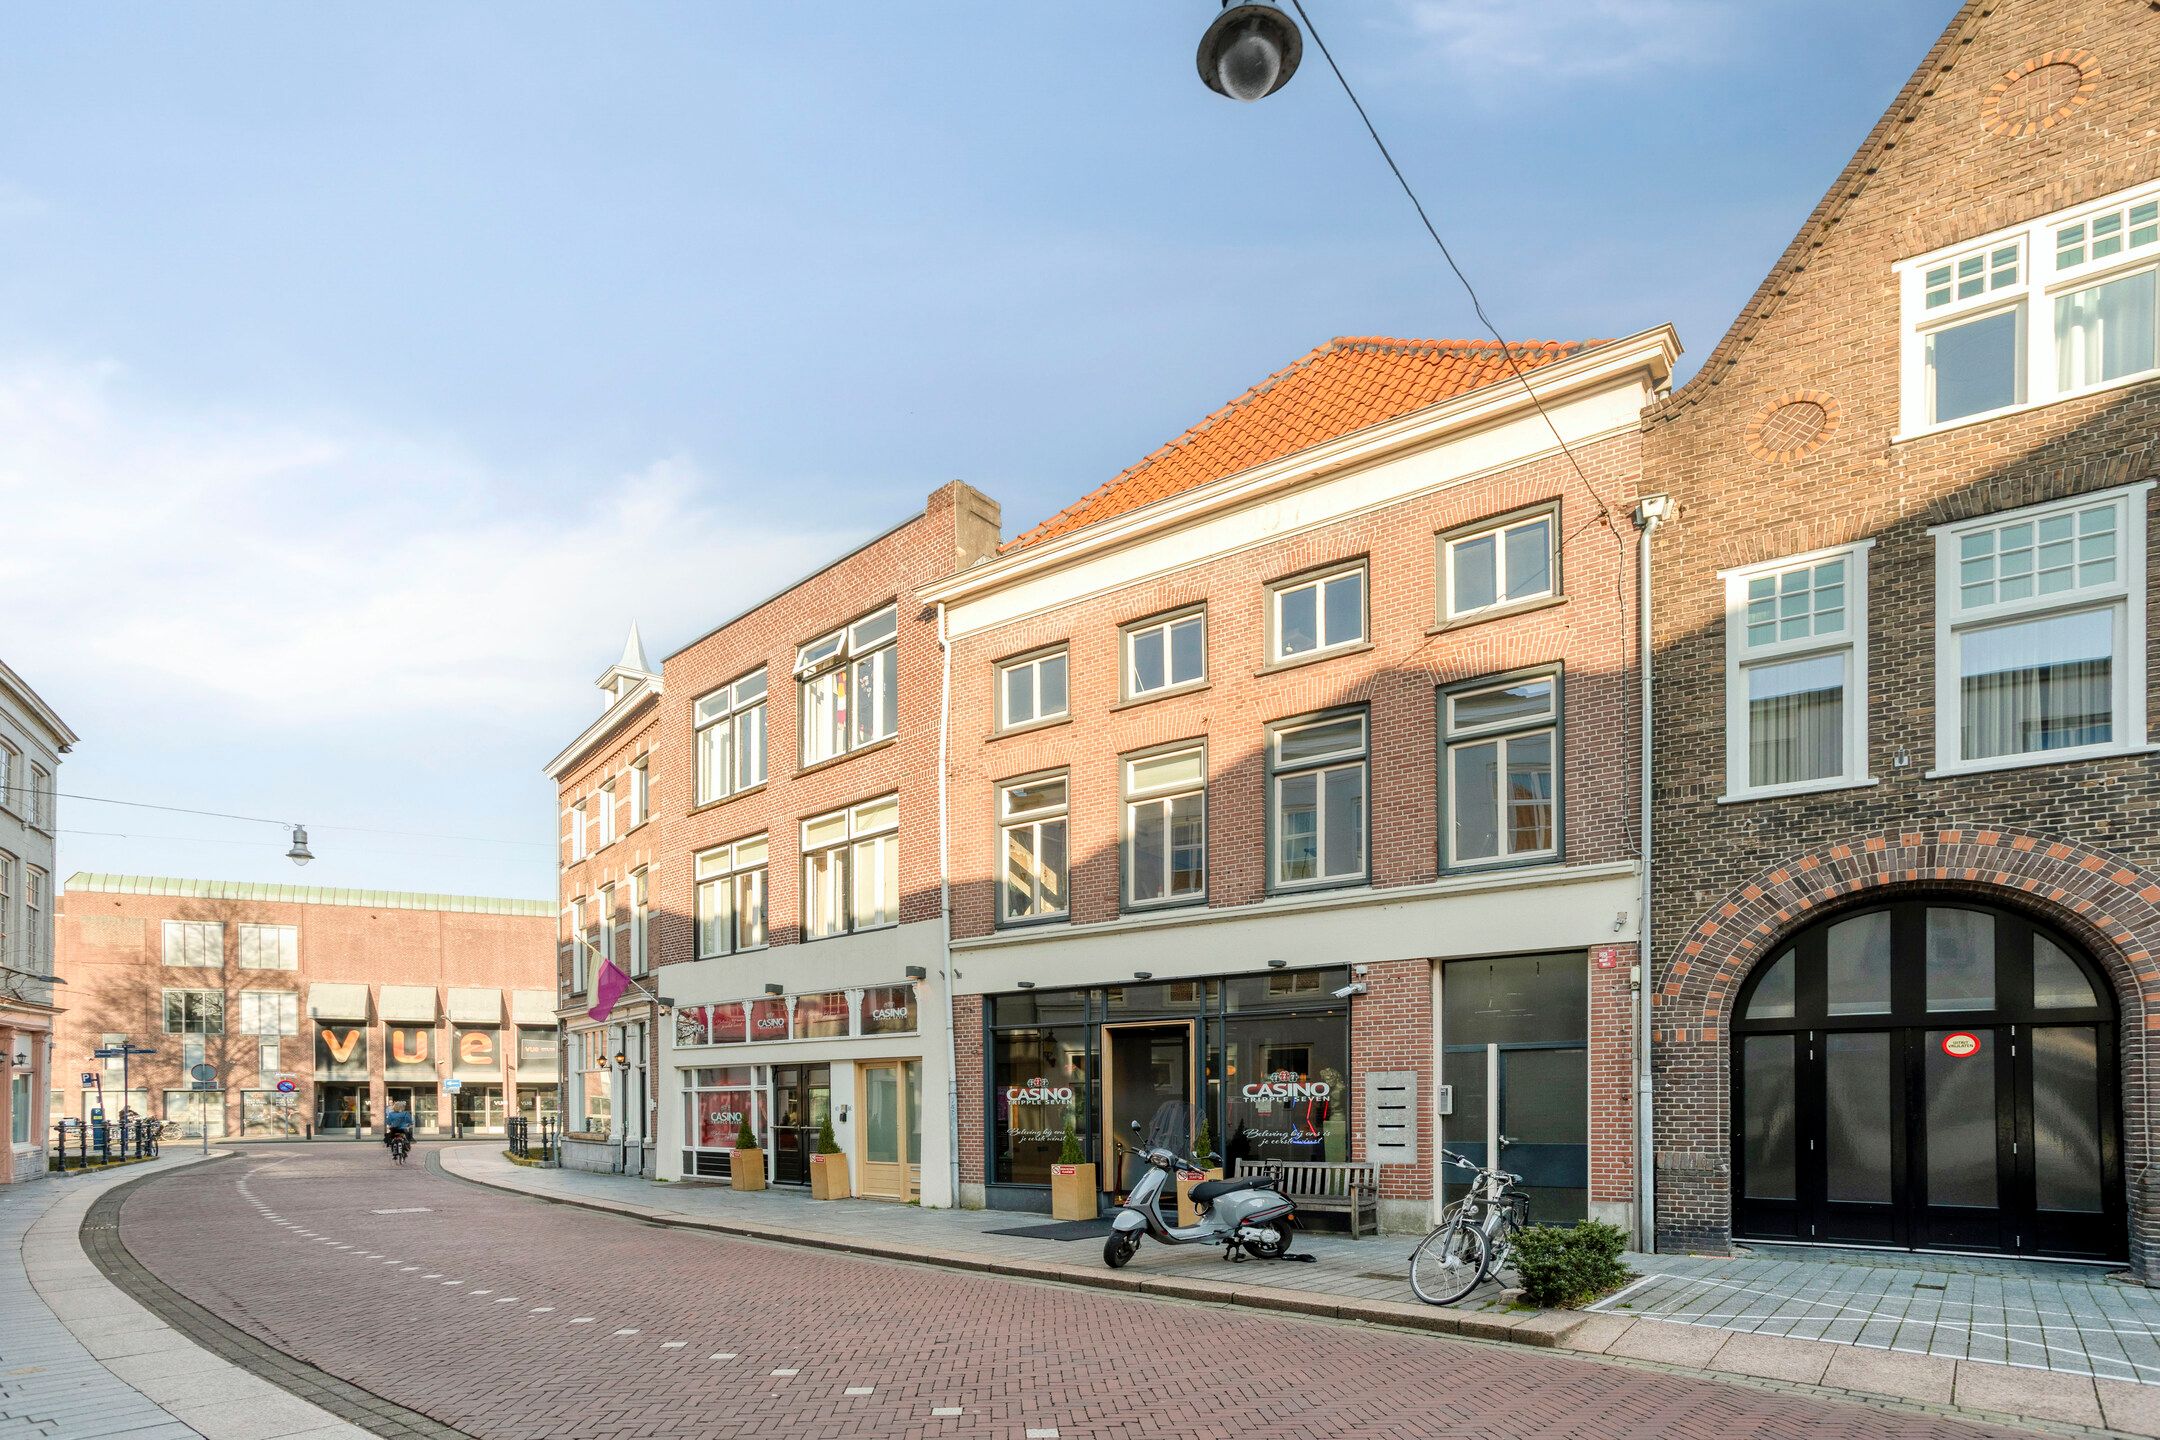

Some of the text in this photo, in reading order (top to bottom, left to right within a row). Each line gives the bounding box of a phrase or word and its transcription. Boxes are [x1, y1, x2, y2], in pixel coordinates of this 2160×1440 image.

[872, 1006, 908, 1018] CASINO
[757, 1018, 784, 1028] CASINO
[82, 1073, 89, 1082] P
[1006, 1087, 1072, 1101] CASINO
[1242, 1082, 1330, 1098] CASINO
[710, 1112, 743, 1121] CASINO
[1242, 1128, 1289, 1139] Beleving
[1257, 1138, 1269, 1147] je
